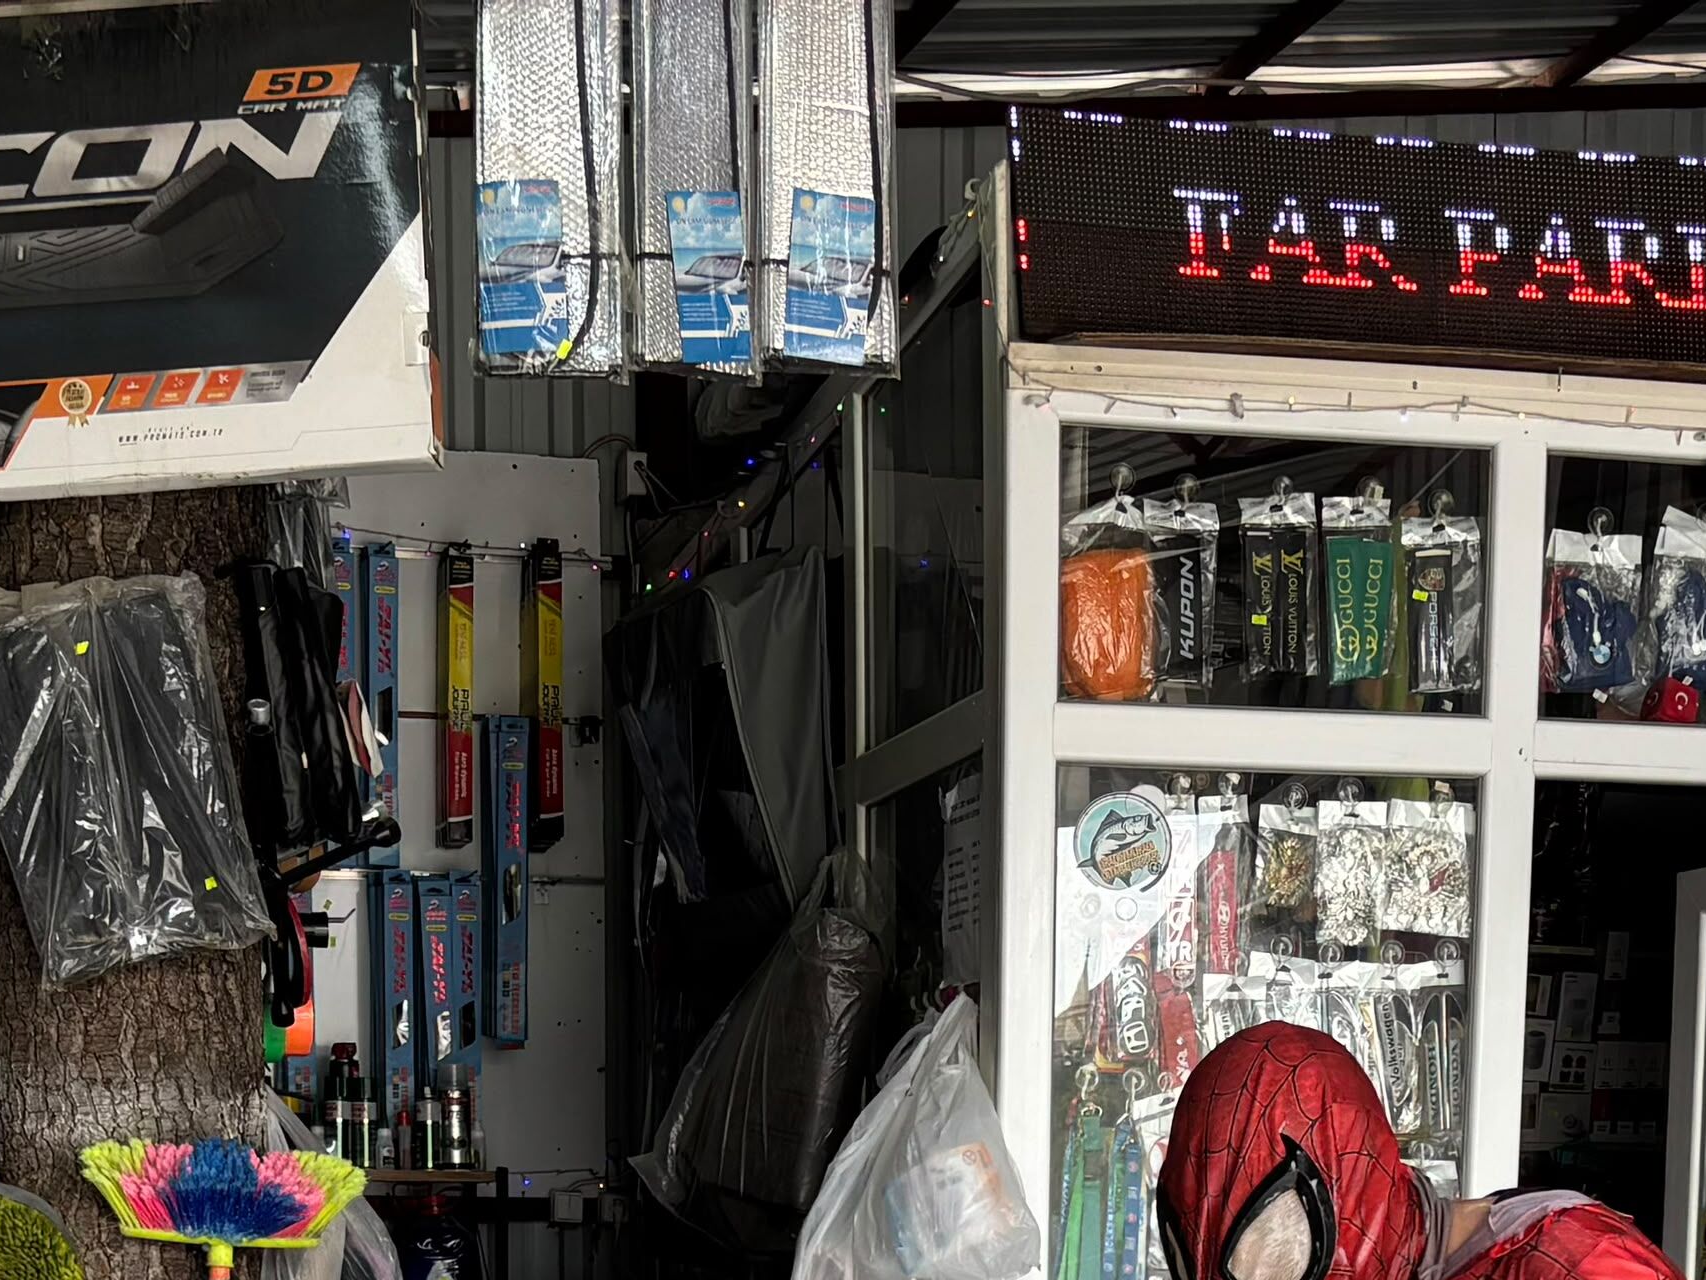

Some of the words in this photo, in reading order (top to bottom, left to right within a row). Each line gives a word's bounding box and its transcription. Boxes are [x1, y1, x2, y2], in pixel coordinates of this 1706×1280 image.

[237, 102, 287, 115] CAR
[296, 97, 346, 111] MAT
[264, 70, 334, 97] 5D
[1179, 556, 1194, 660] KUPON
[1336, 558, 1355, 626] GUCCI
[1363, 558, 1384, 626] GUCCI
[460, 688, 470, 731] PAUL
[550, 684, 561, 727] PAUL
[1381, 1002, 1400, 1086] Volkswagen
